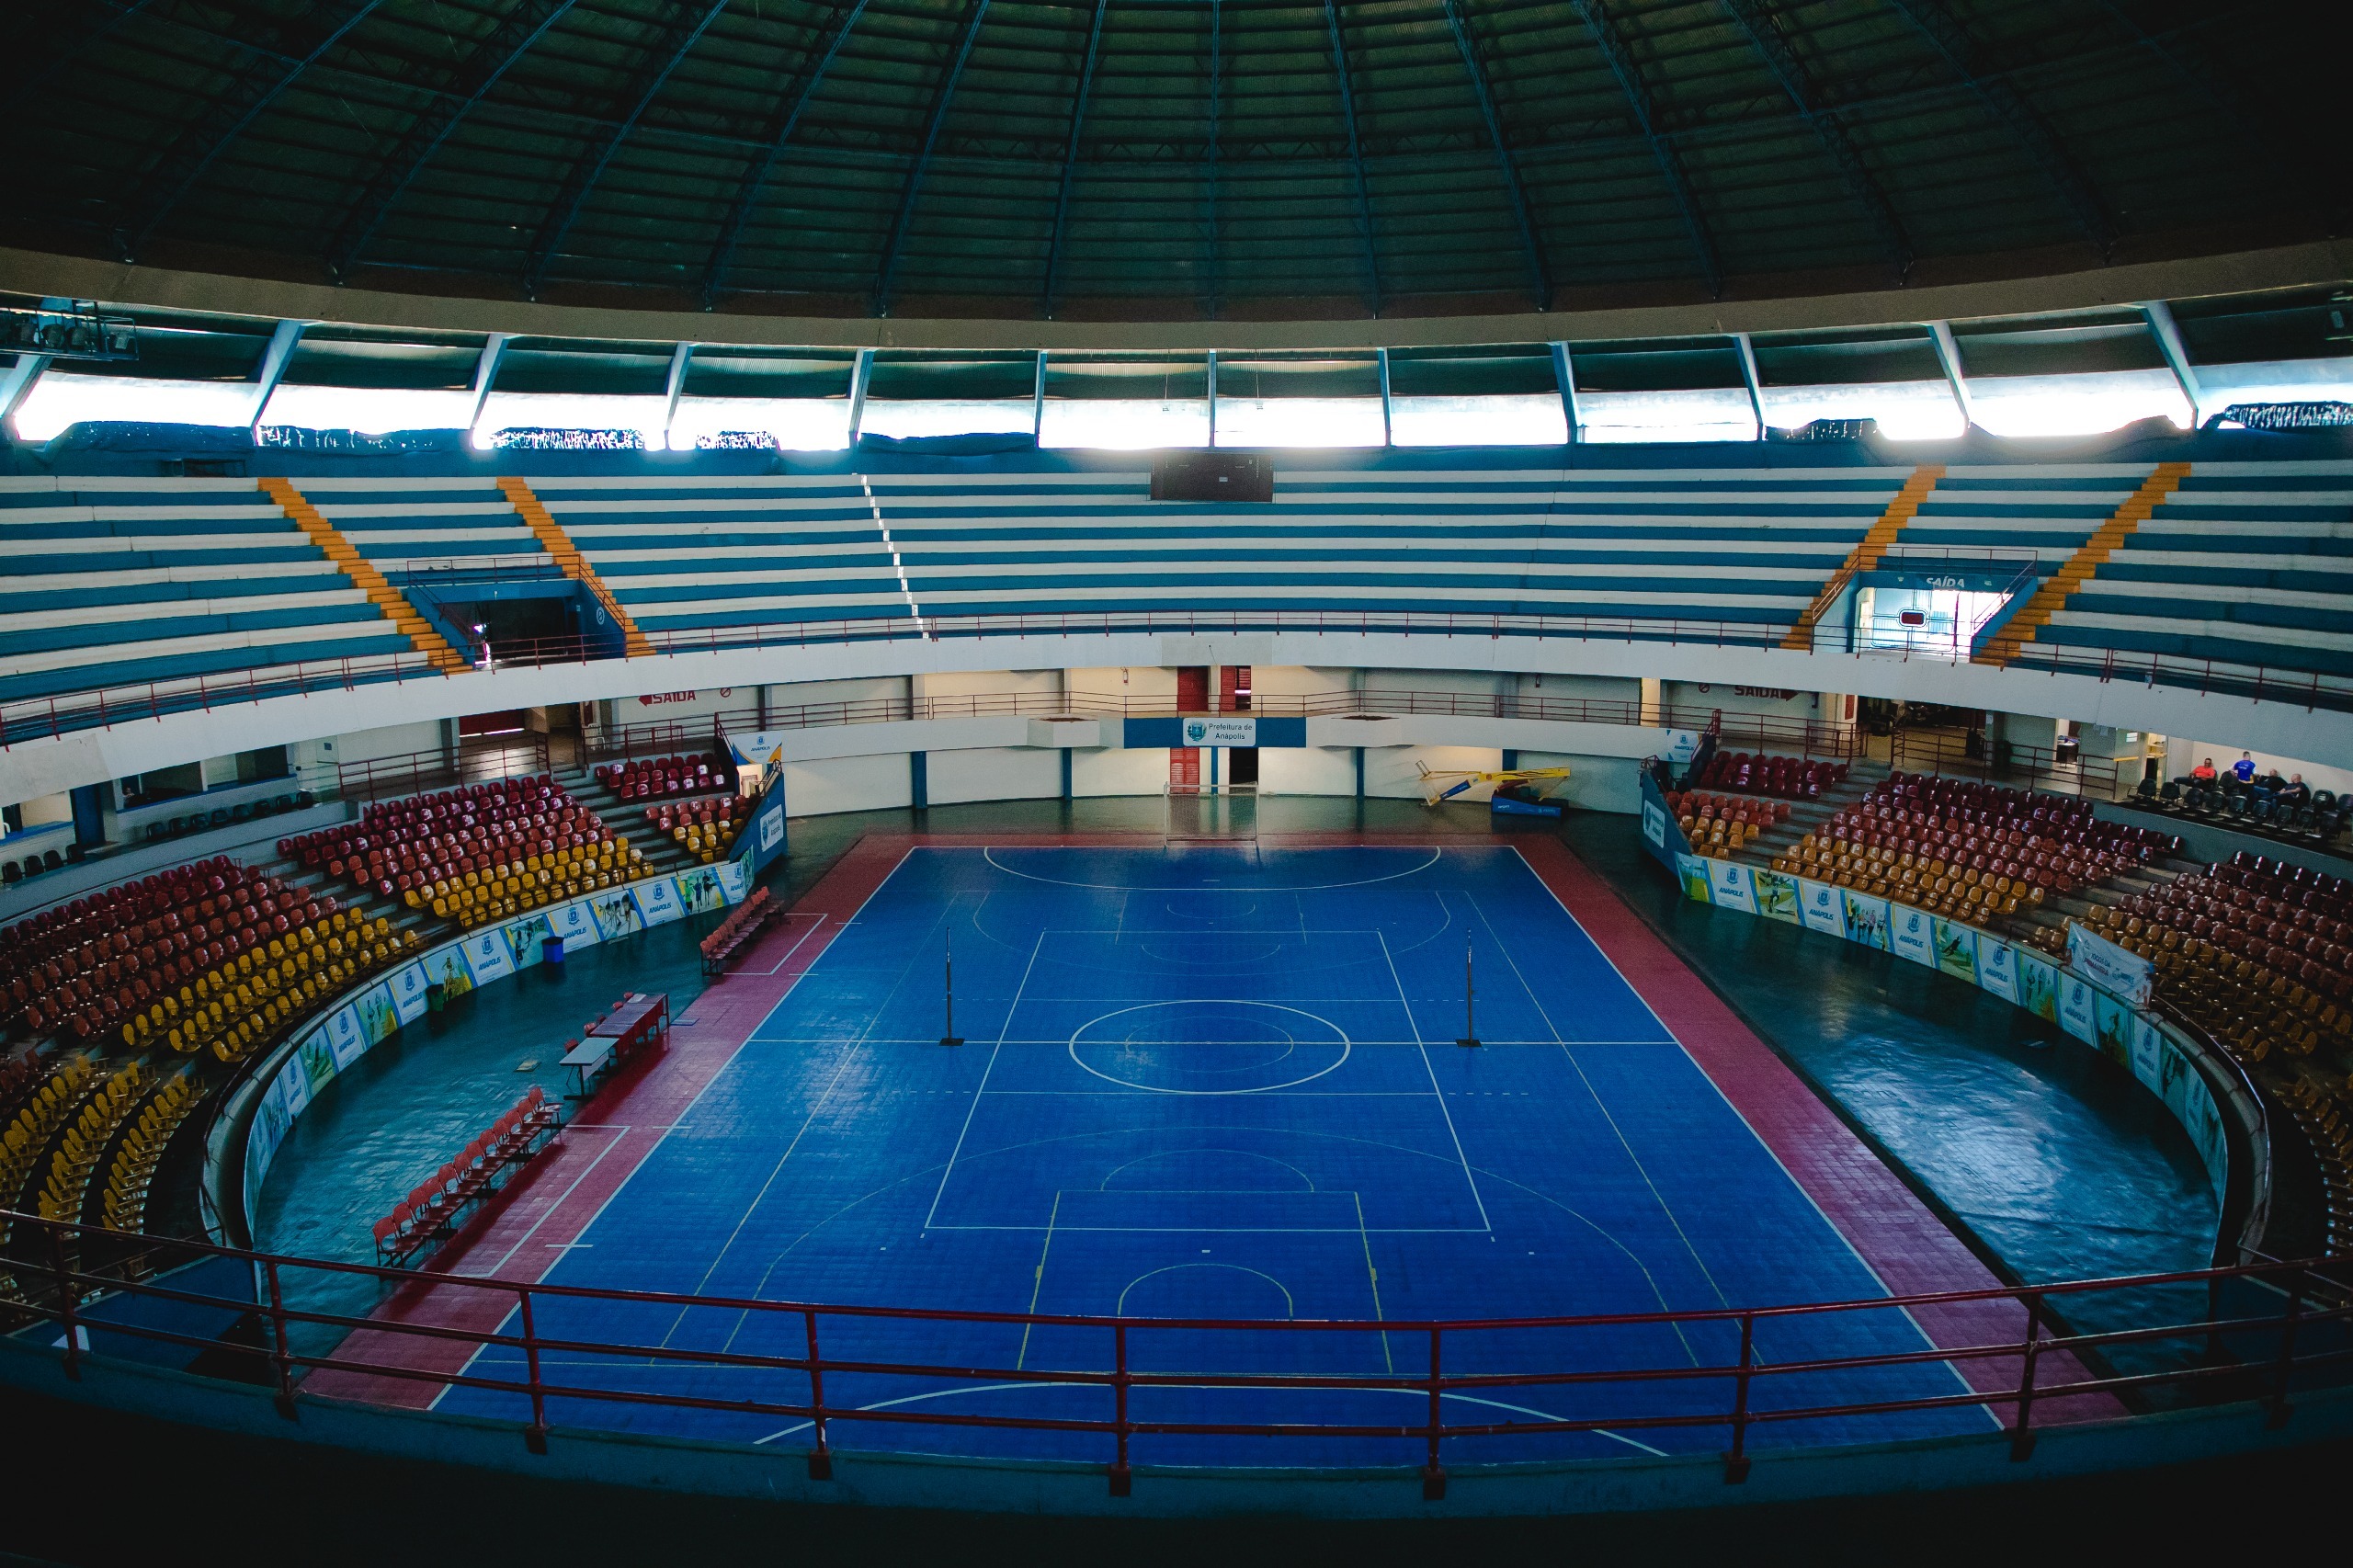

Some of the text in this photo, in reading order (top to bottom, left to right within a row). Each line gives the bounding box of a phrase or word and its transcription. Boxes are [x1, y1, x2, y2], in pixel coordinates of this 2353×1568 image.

[1209, 722, 1253, 732] Prefeitura de
[1215, 732, 1245, 742] Anápolis
